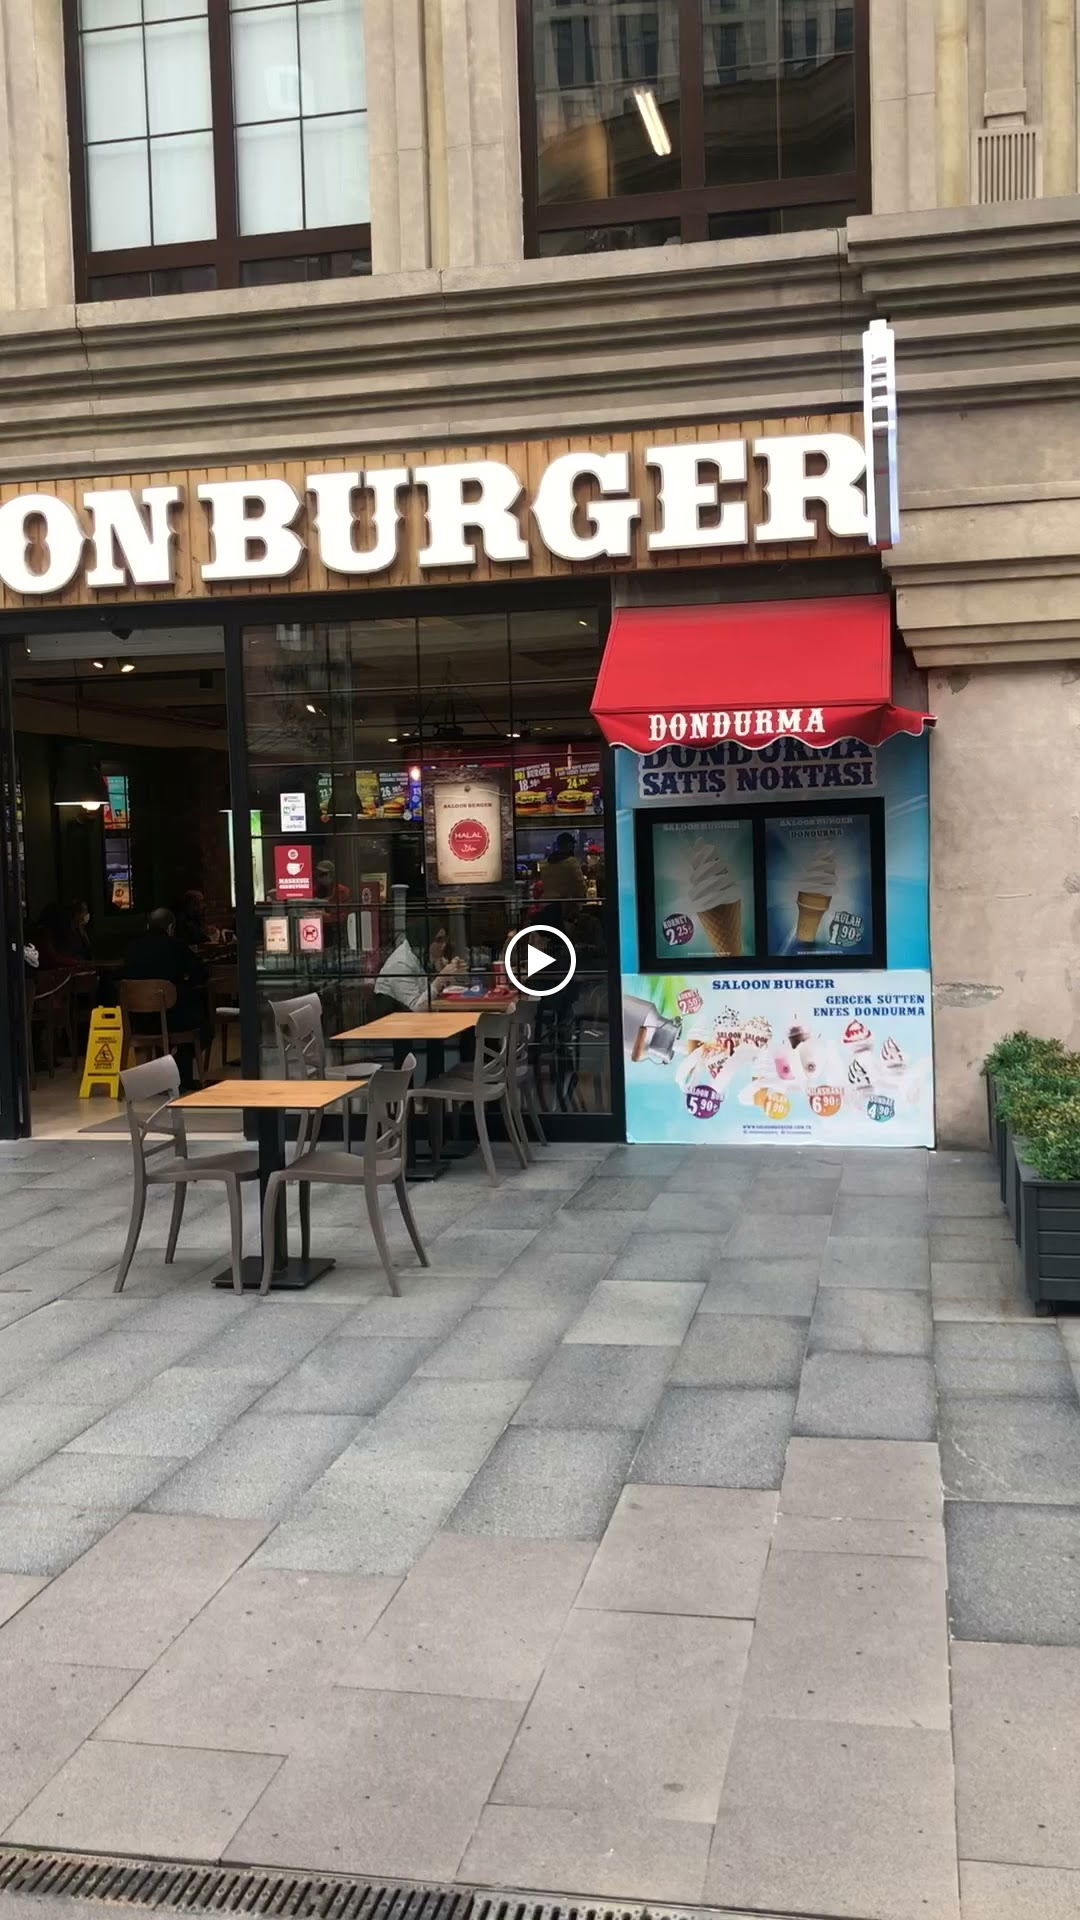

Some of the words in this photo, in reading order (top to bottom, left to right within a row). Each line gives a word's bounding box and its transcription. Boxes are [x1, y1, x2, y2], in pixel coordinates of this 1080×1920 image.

[648, 707, 826, 741] DONDURMA
[643, 769, 727, 797] SATIŞ
[736, 762, 874, 791] NOKTASI
[790, 828, 842, 838] DONDURMA
[712, 980, 770, 990] SALOON
[773, 979, 835, 989] BURGER
[813, 1007, 850, 1016] ENFES
[854, 1006, 925, 1016] DONDURMA
[717, 1031, 742, 1039] SALOON
